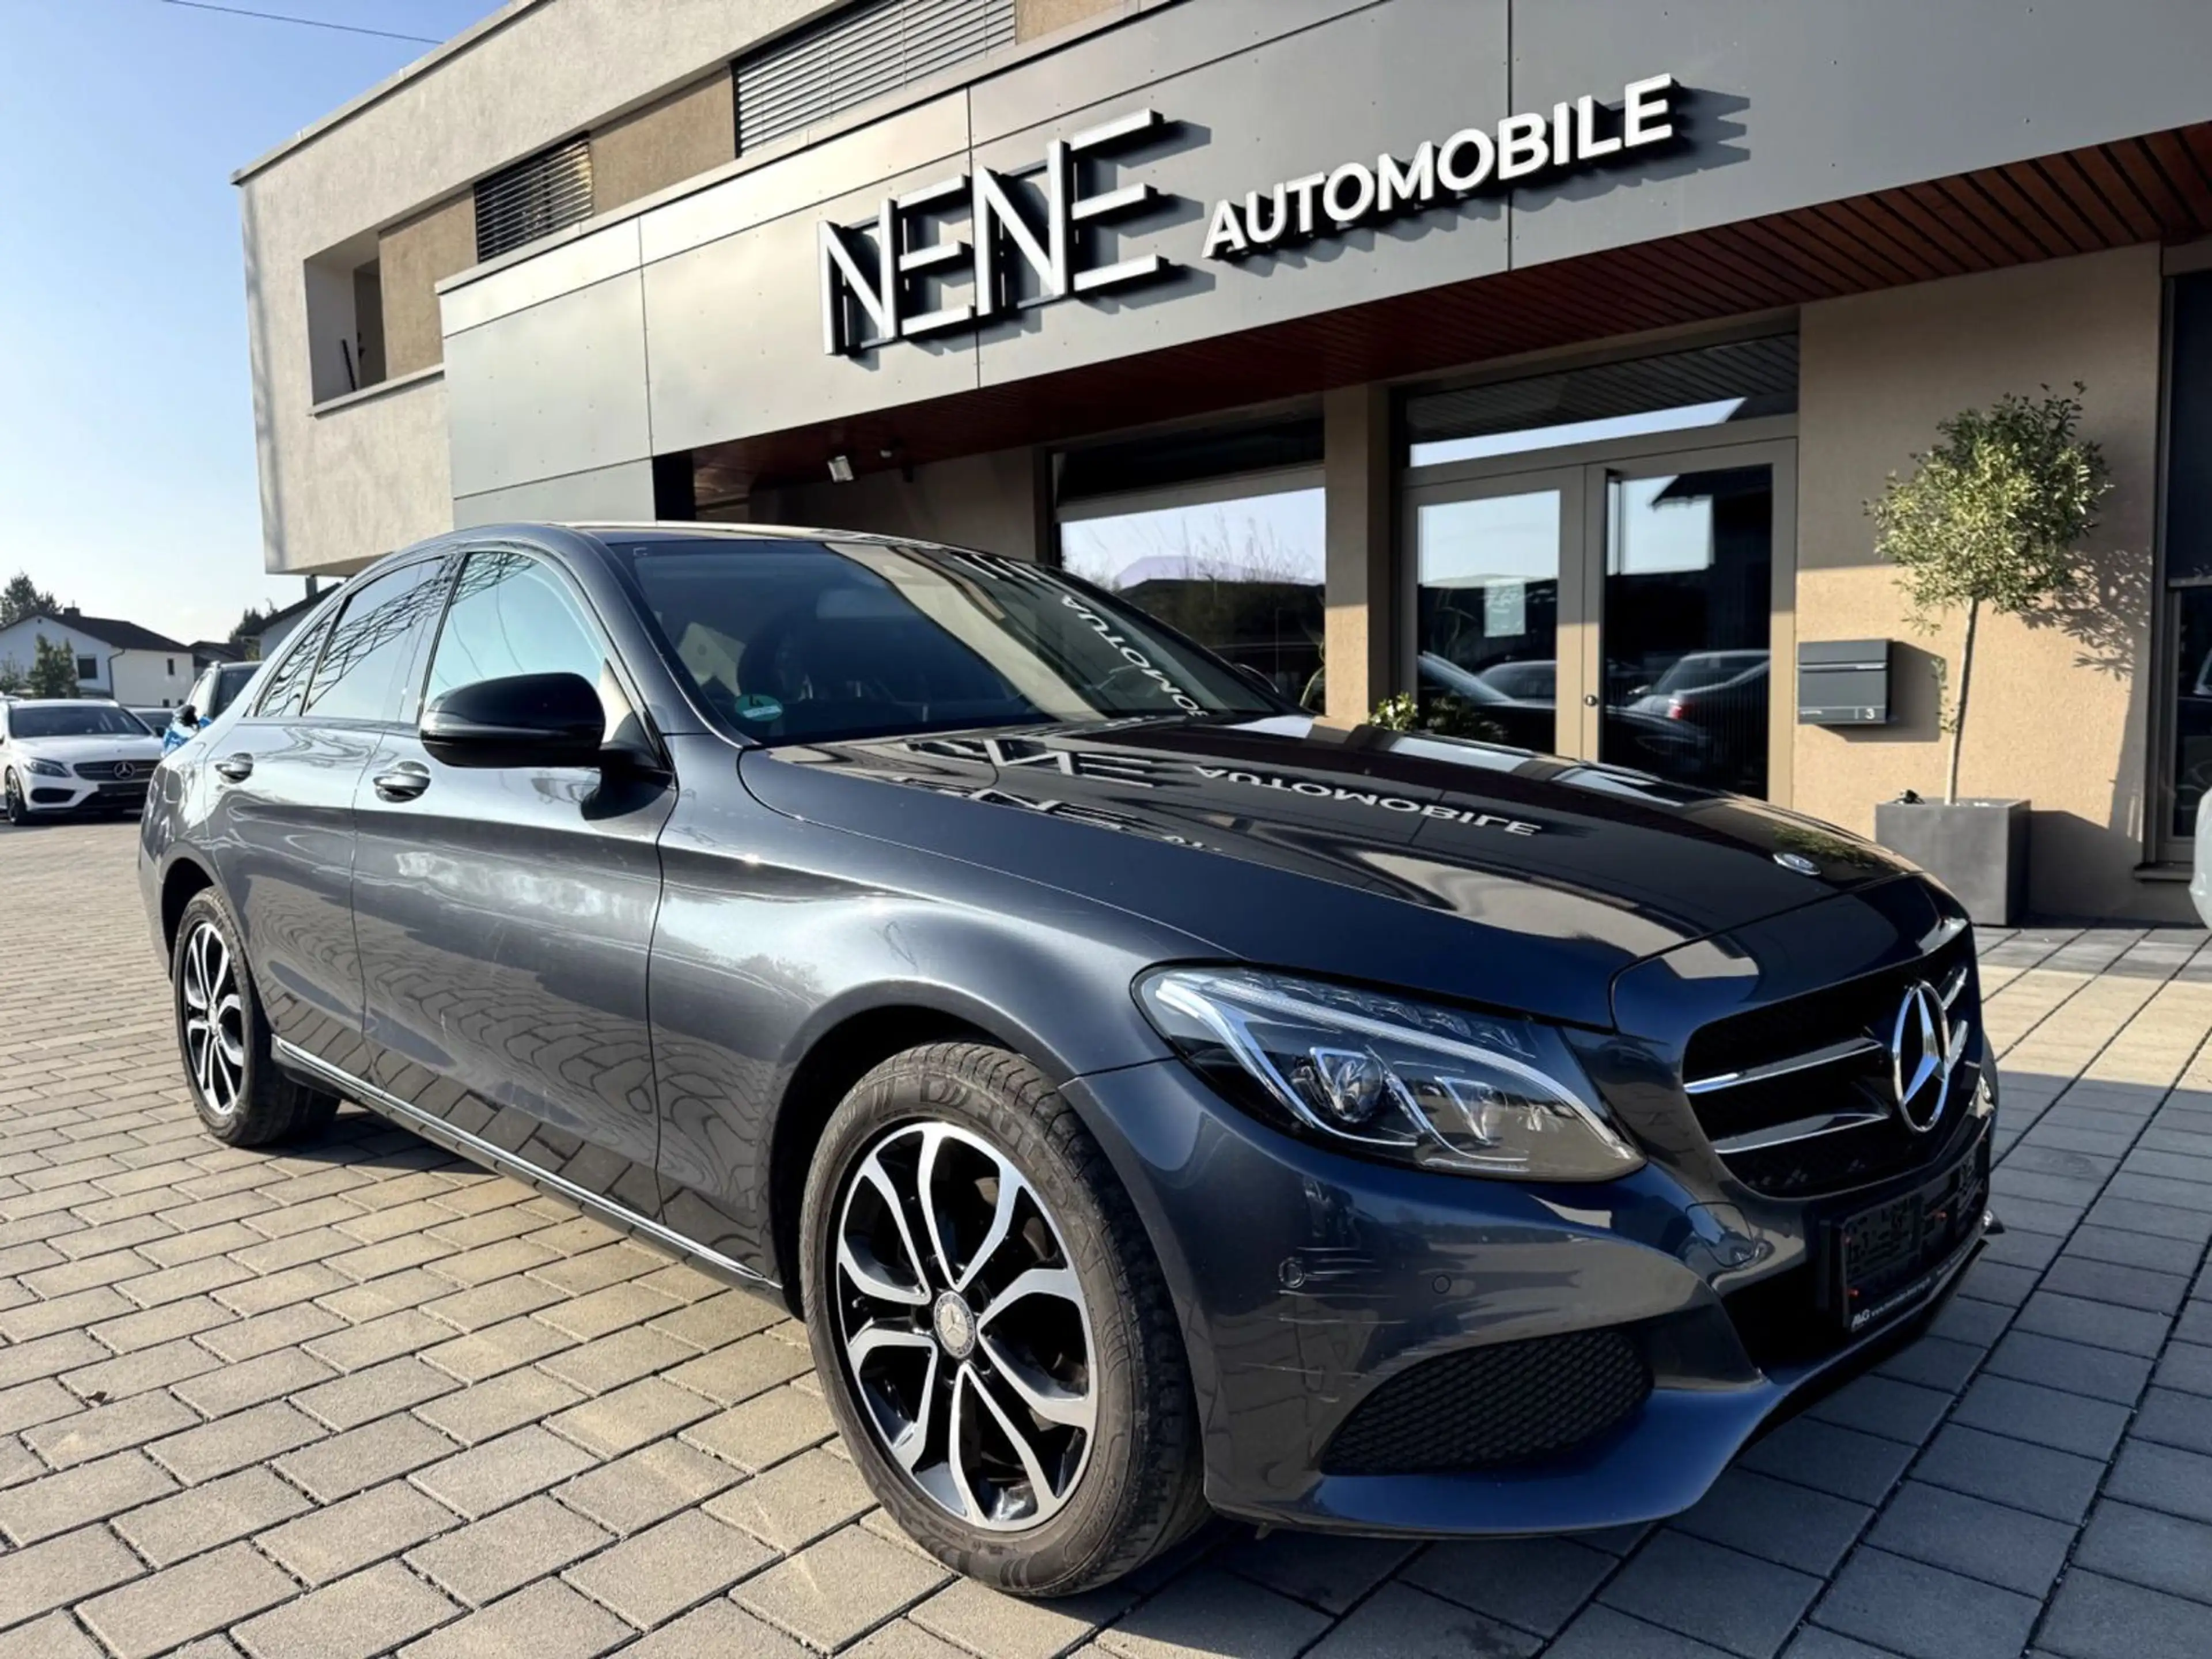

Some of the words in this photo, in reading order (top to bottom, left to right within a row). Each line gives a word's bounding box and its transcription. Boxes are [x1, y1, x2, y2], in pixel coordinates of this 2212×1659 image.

[817, 108, 1165, 355] NENE
[1202, 72, 1673, 259] AUTOMOBILE
[1865, 707, 1875, 720] 3
